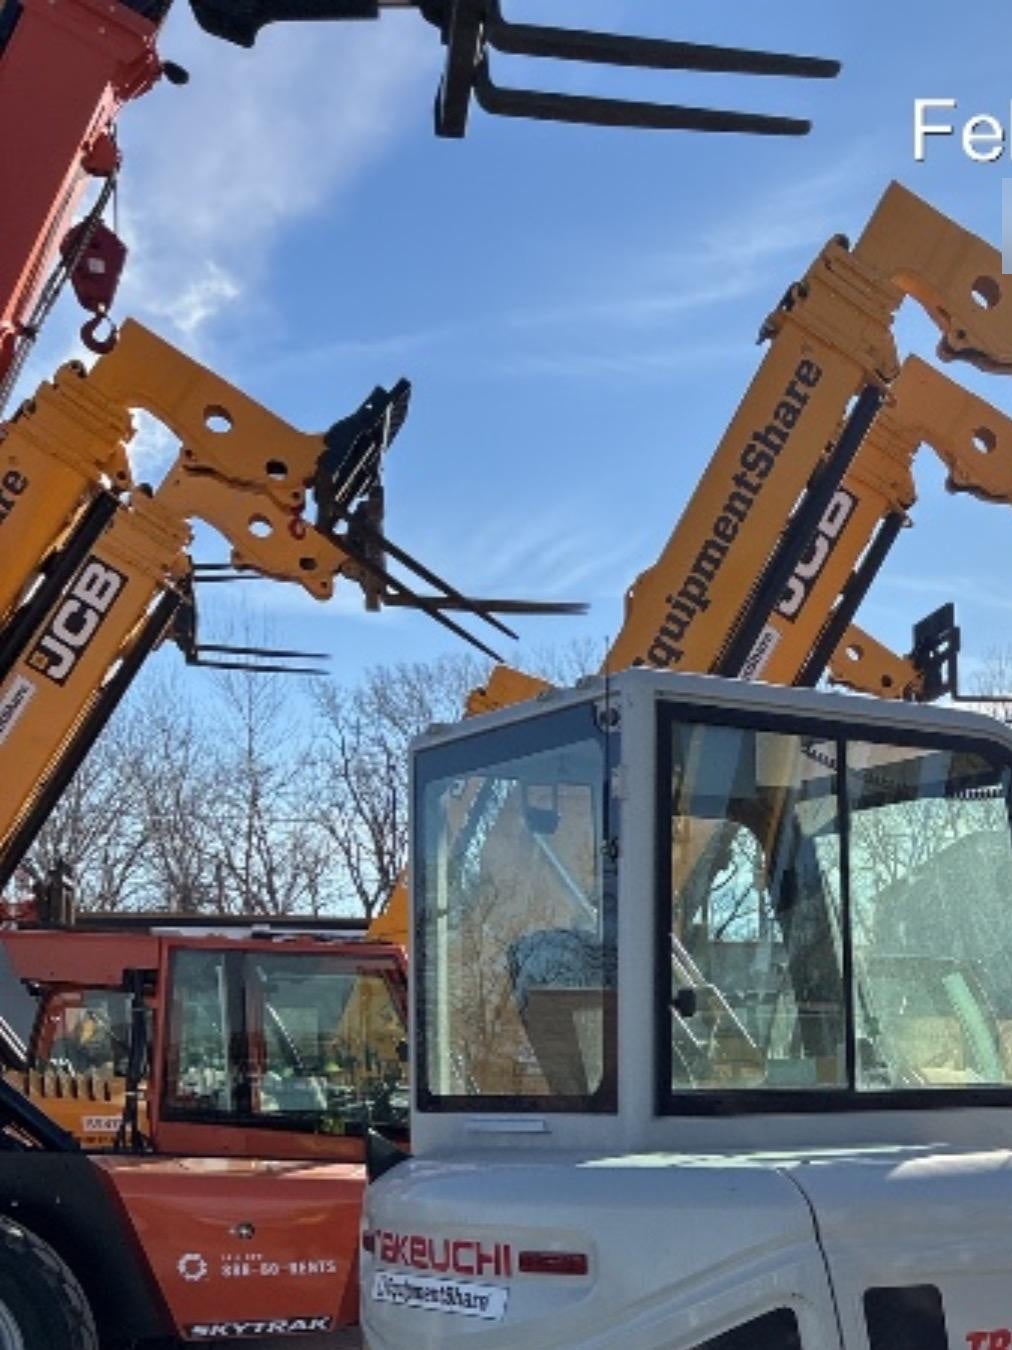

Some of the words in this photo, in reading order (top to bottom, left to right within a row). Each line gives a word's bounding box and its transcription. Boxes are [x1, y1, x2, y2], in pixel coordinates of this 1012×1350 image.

[633, 358, 823, 668] quipmentShare
[39, 563, 126, 680] JCB
[374, 1230, 512, 1277] AKEUCHI
[191, 1317, 331, 1336] SKYTRAK
